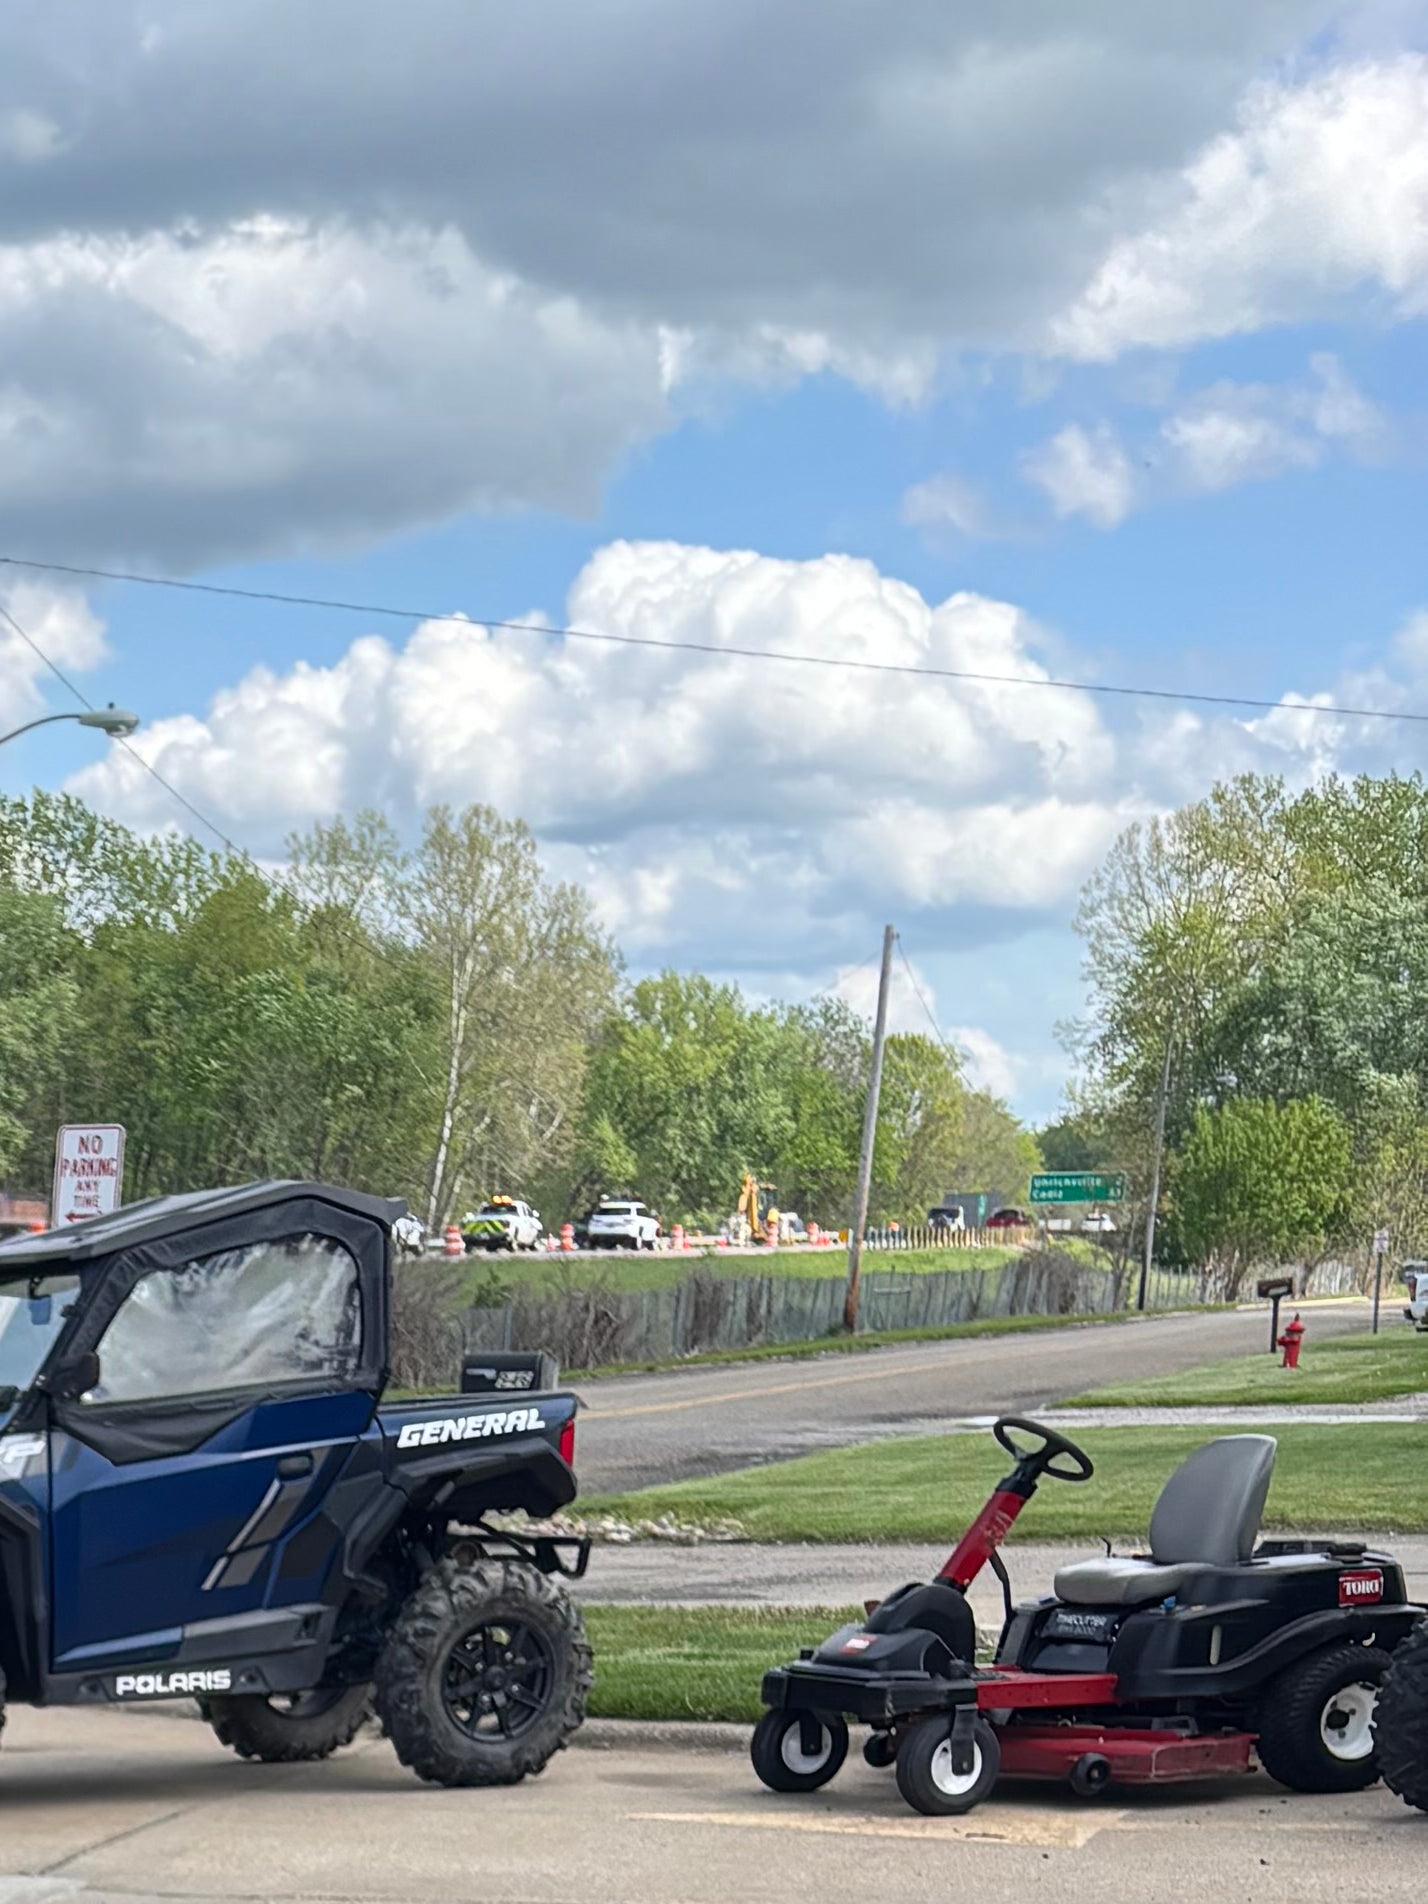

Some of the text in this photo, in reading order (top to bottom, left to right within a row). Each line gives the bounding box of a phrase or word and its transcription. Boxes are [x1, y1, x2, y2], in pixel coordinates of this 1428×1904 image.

[78, 1135, 103, 1154] NO
[61, 1158, 117, 1177] PARKING
[75, 1180, 100, 1192] ANY
[73, 1195, 99, 1208] TIME
[396, 1408, 546, 1448] GENERAL
[1343, 1579, 1380, 1596] TORO
[115, 1669, 232, 1696] POLARIS
